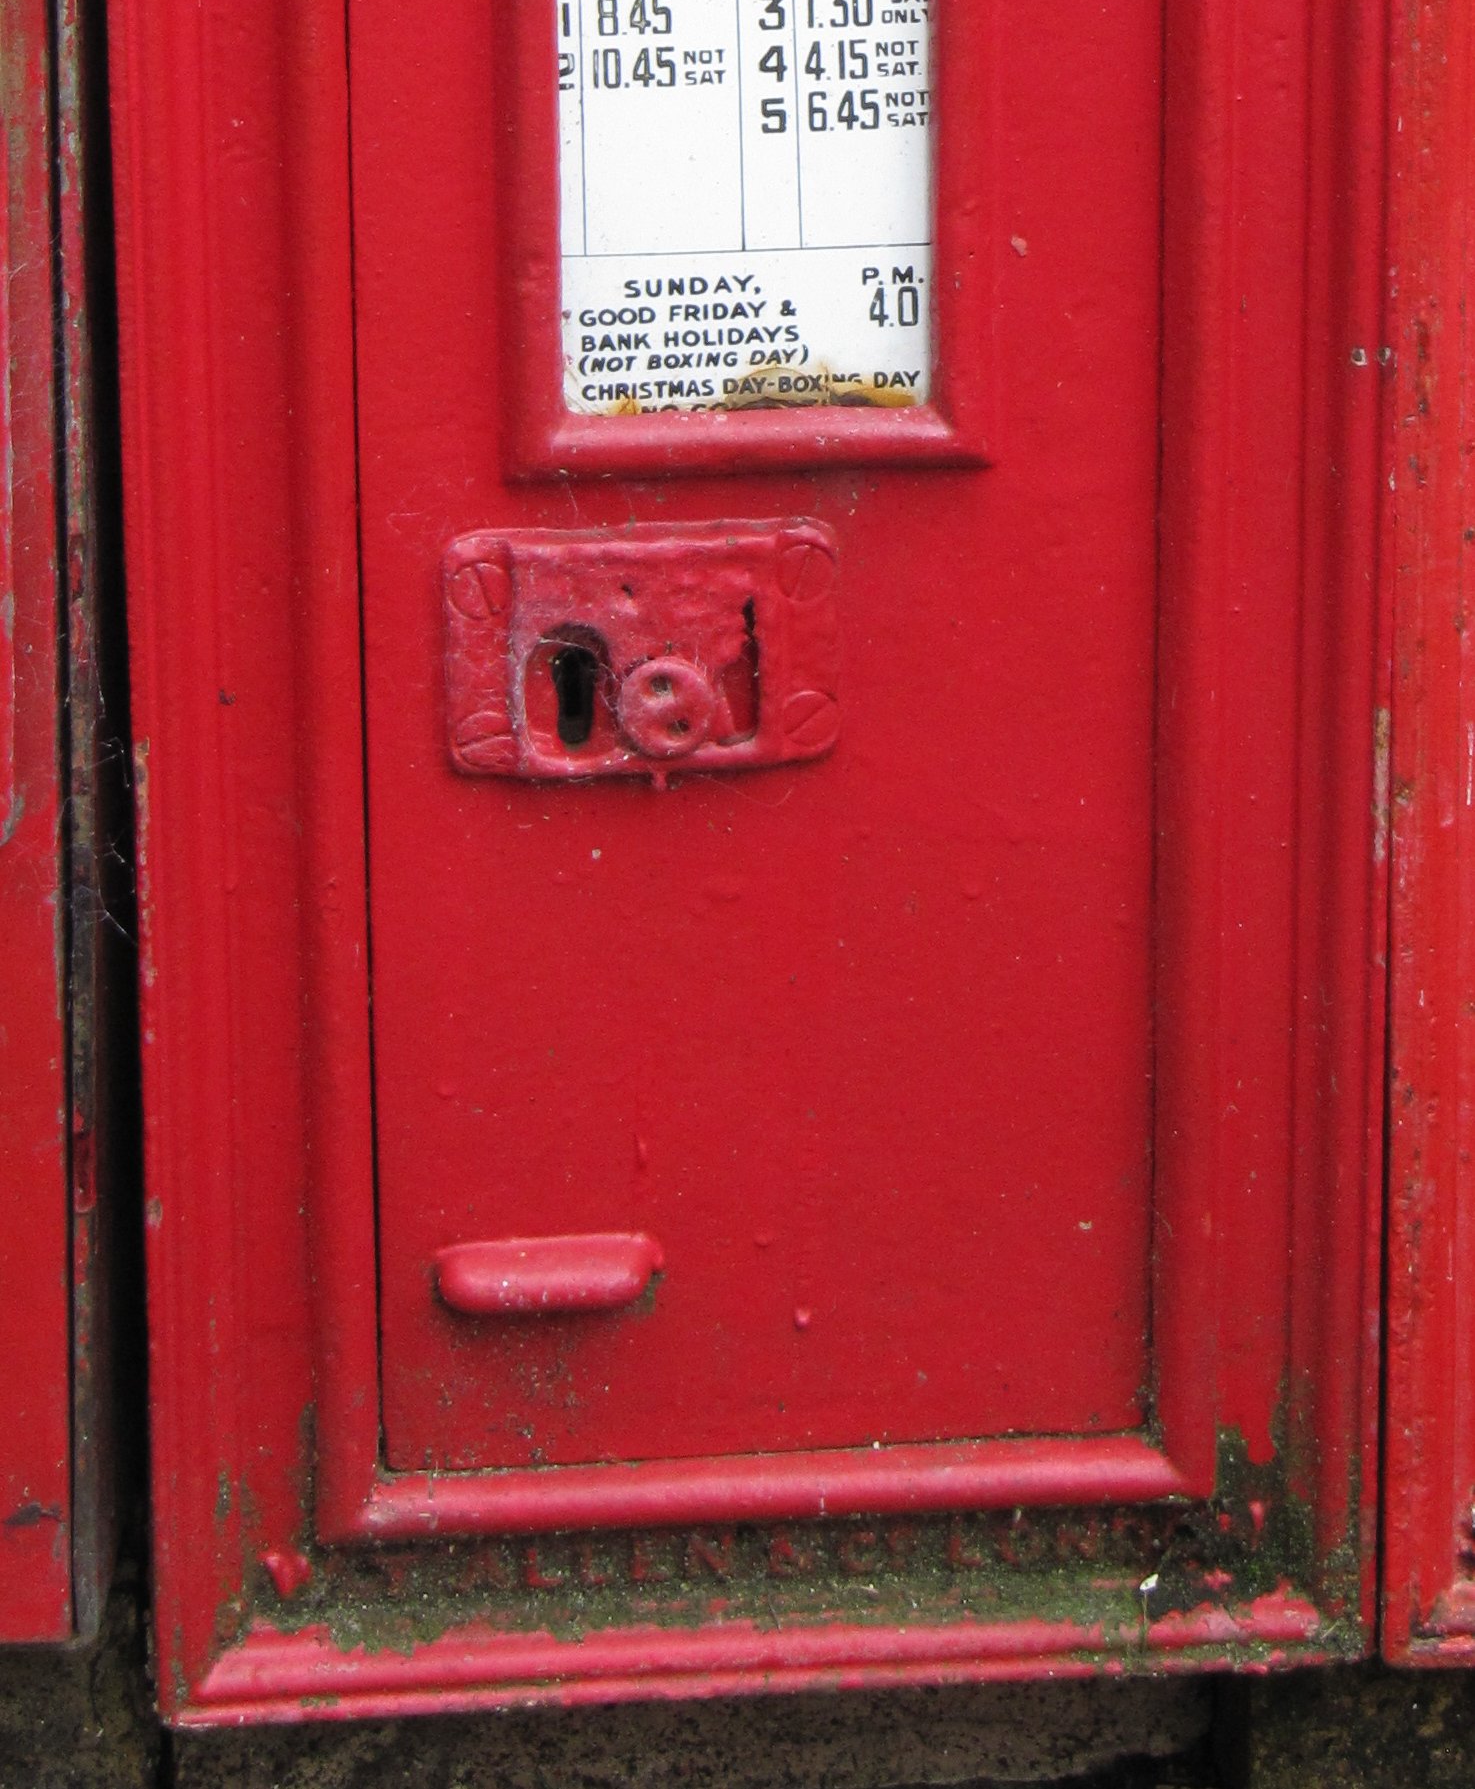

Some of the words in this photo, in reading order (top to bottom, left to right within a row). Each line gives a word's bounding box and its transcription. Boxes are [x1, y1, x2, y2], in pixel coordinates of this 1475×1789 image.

[683, 48, 726, 66] NOT
[758, 45, 788, 83] 4
[804, 39, 869, 82] 4.15
[875, 40, 920, 57] NOT
[592, 46, 677, 90] 10.45
[684, 68, 727, 87] SAT
[761, 98, 787, 134] 5
[808, 89, 880, 132] 6.45
[885, 91, 930, 108] NOT
[886, 112, 930, 128] SAT
[623, 274, 763, 299] SUNDAY,
[861, 265, 925, 287] P.M.
[578, 308, 656, 328] GOOD
[668, 300, 768, 323] FRIDAY
[779, 299, 798, 319] &
[868, 286, 920, 329] 4.0
[581, 334, 651, 353] BANK
[663, 325, 800, 348] HOLIDAYS
[578, 354, 638, 377] (NOT
[646, 349, 738, 370] BOXING
[748, 344, 810, 366] DAY)
[581, 377, 716, 402] CHRISTMAS
[873, 370, 922, 390] DAY
